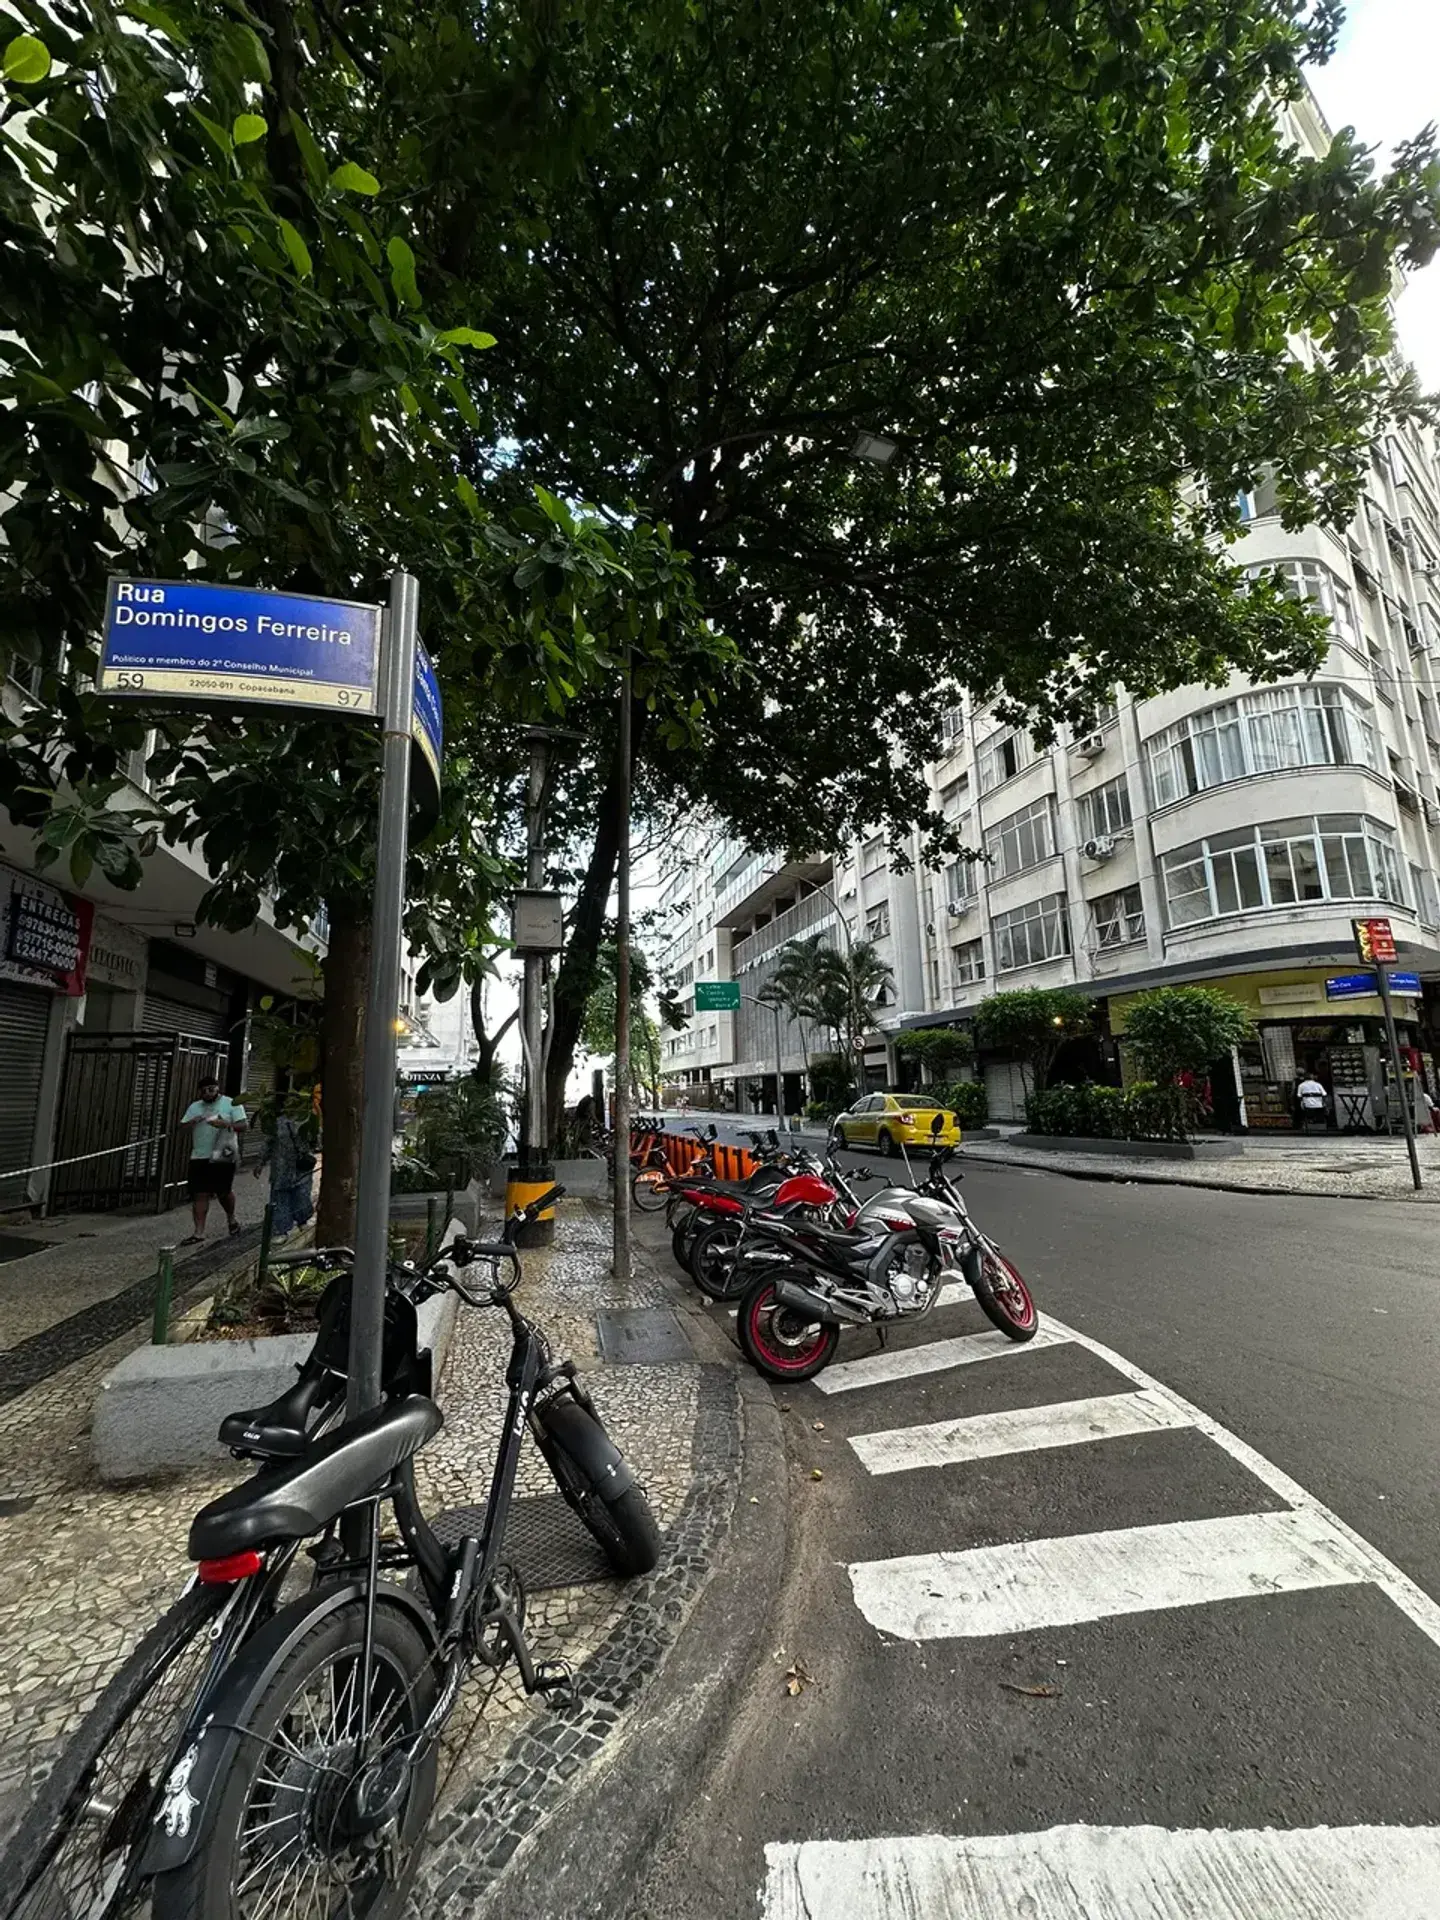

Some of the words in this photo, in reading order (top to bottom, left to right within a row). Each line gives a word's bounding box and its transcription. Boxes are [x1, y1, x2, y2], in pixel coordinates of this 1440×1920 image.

[117, 583, 165, 603] Rua
[115, 606, 248, 633] Domingos
[257, 616, 352, 645] Ferreira
[156, 656, 196, 666] membro
[198, 658, 210, 667] do
[223, 660, 267, 672] Conselho
[117, 672, 144, 689] 59
[238, 682, 295, 695] Copacabana
[337, 690, 363, 707] 97
[21, 896, 81, 930] ENTREGAS
